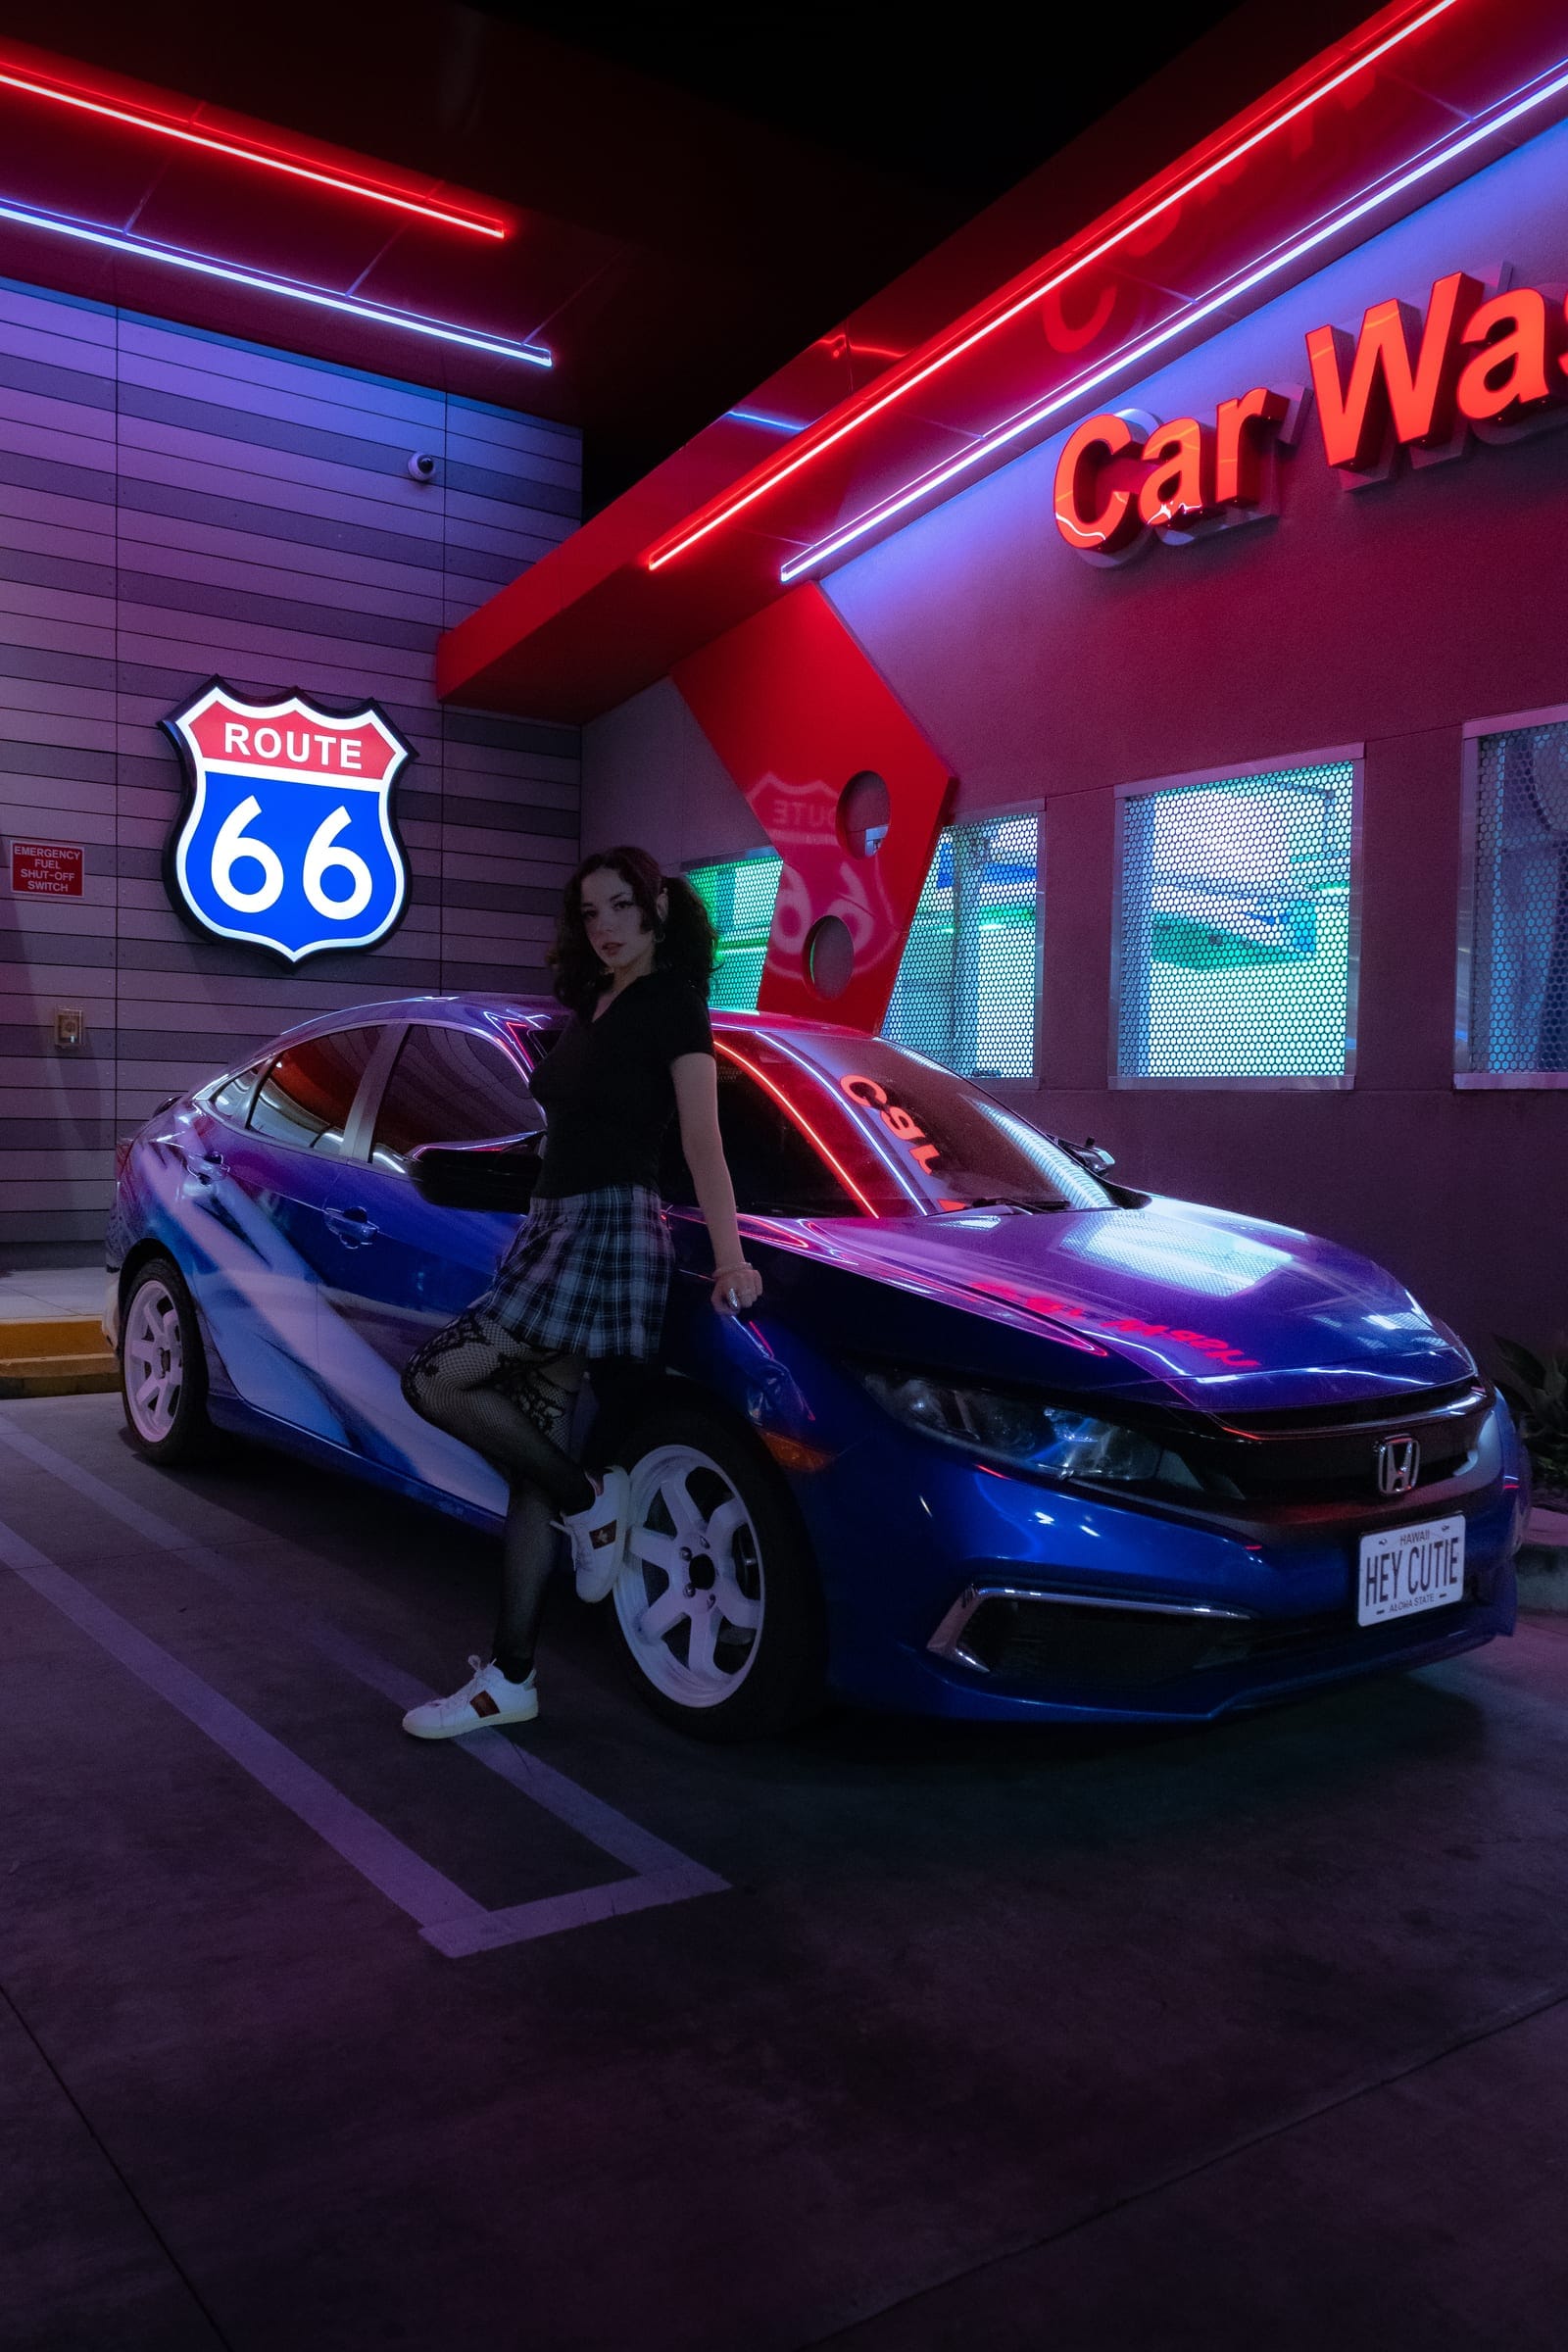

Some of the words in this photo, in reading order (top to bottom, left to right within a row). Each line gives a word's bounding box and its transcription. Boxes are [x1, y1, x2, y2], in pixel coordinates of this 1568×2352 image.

[1054, 387, 1277, 549] Car
[1304, 270, 1568, 467] Wa
[223, 721, 363, 770] ROUTE
[14, 846, 80, 860] EMERGENCY
[211, 795, 372, 920] 66
[34, 858, 62, 869] FUEL
[21, 868, 75, 881] SHUT-OFF
[27, 880, 69, 892] SWITCH
[1399, 1530, 1430, 1545] HAWAII
[1366, 1550, 1403, 1607] HEY
[1408, 1537, 1459, 1594] CUTIE
[1389, 1598, 1413, 1613] ALOHA
[1414, 1593, 1435, 1607] STATE
